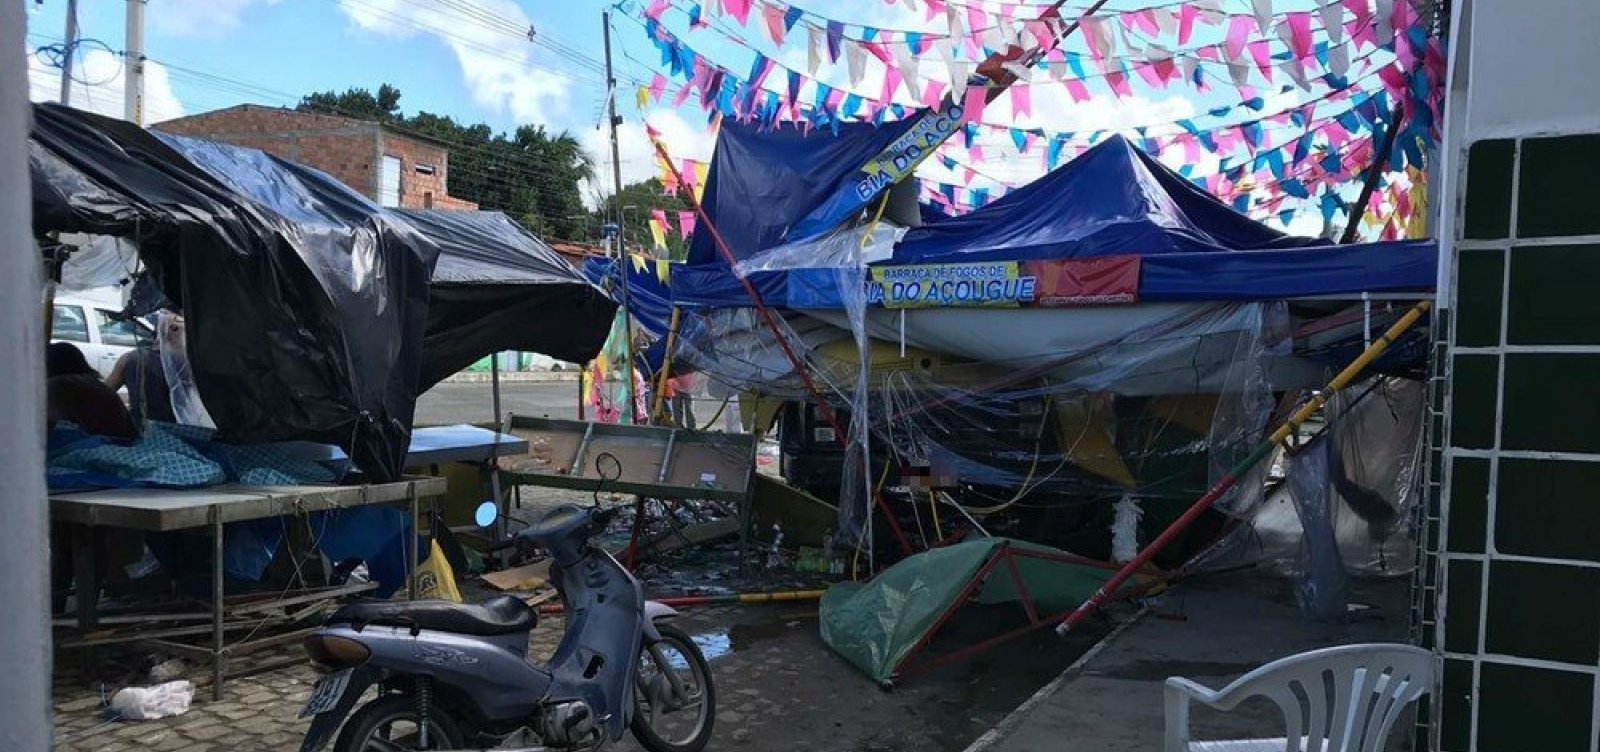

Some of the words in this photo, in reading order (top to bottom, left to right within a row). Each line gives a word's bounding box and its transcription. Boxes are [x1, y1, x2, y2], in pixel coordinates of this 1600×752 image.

[856, 171, 893, 202] BIA
[893, 144, 922, 172] DO
[934, 266, 948, 279] DE
[951, 265, 986, 278] FOGOS
[990, 264, 1005, 278] DE
[892, 281, 921, 302] DO
[923, 276, 1036, 305] AÇOUGUE
